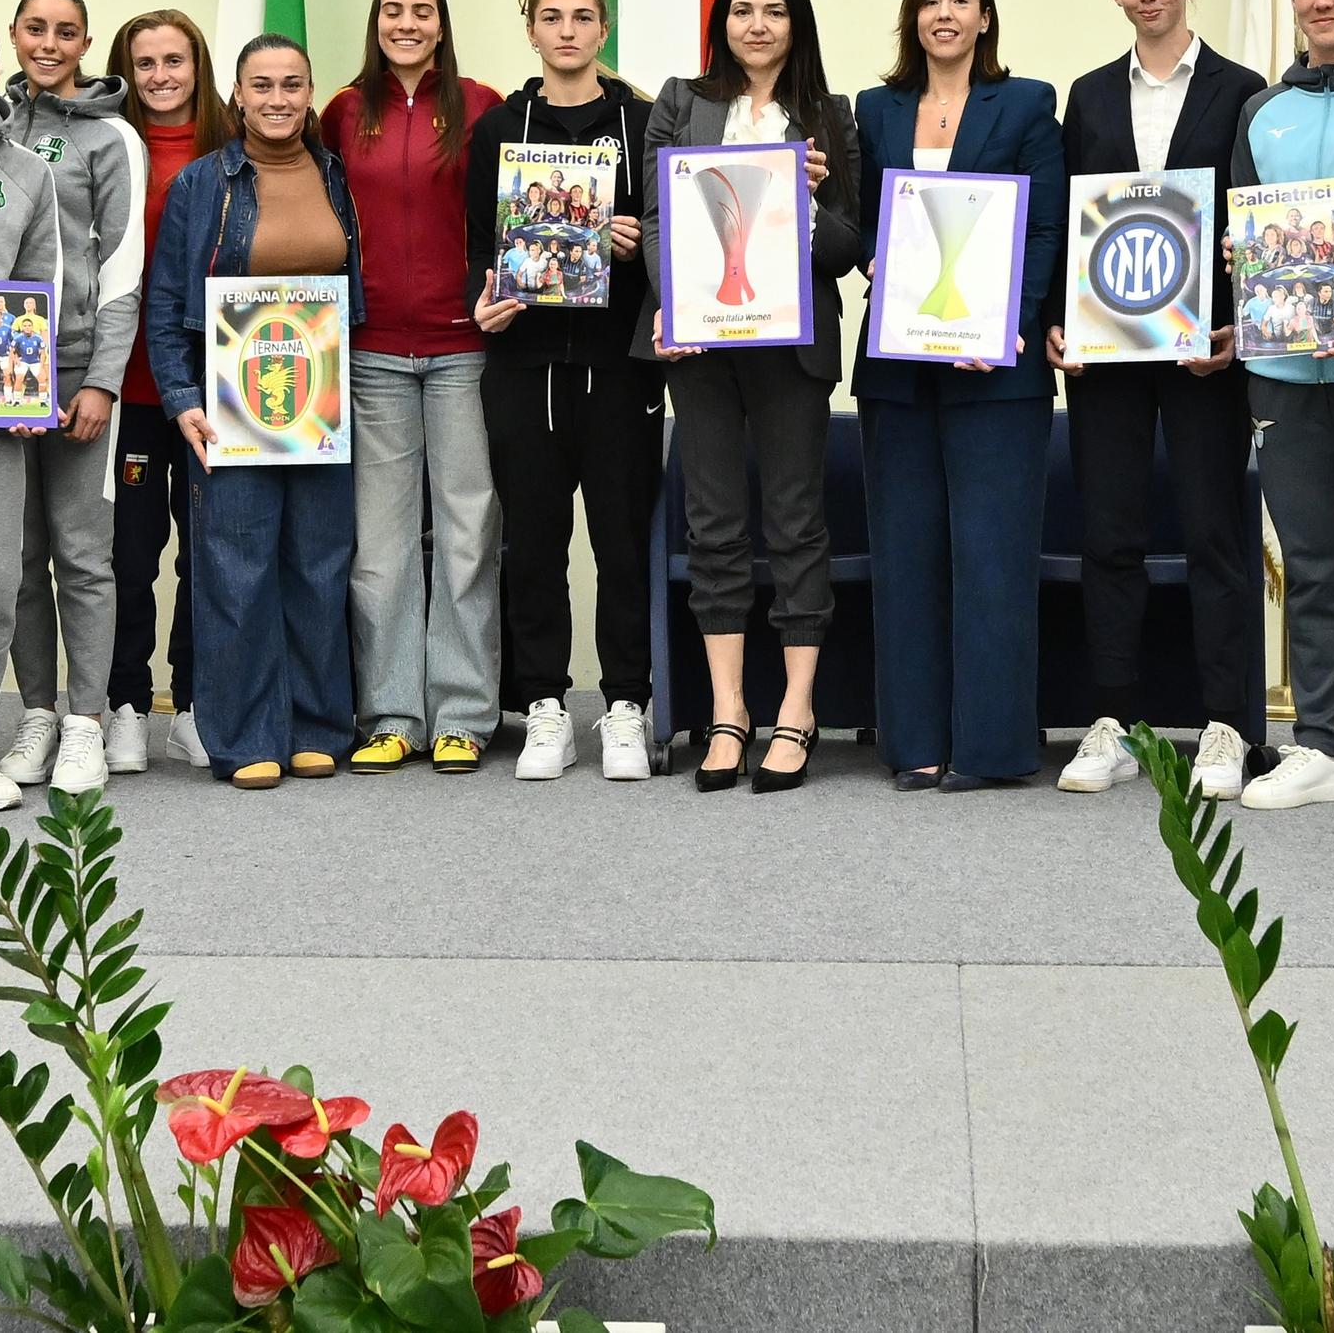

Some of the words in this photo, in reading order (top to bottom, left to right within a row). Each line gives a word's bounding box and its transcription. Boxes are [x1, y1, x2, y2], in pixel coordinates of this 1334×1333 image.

[504, 149, 592, 165] Calciatrici
[1122, 185, 1162, 198] INTER
[1232, 184, 1331, 208] Calciatrici
[218, 290, 280, 304] TERNANA
[283, 289, 337, 303] WOMEN
[253, 339, 304, 355] TERNANA
